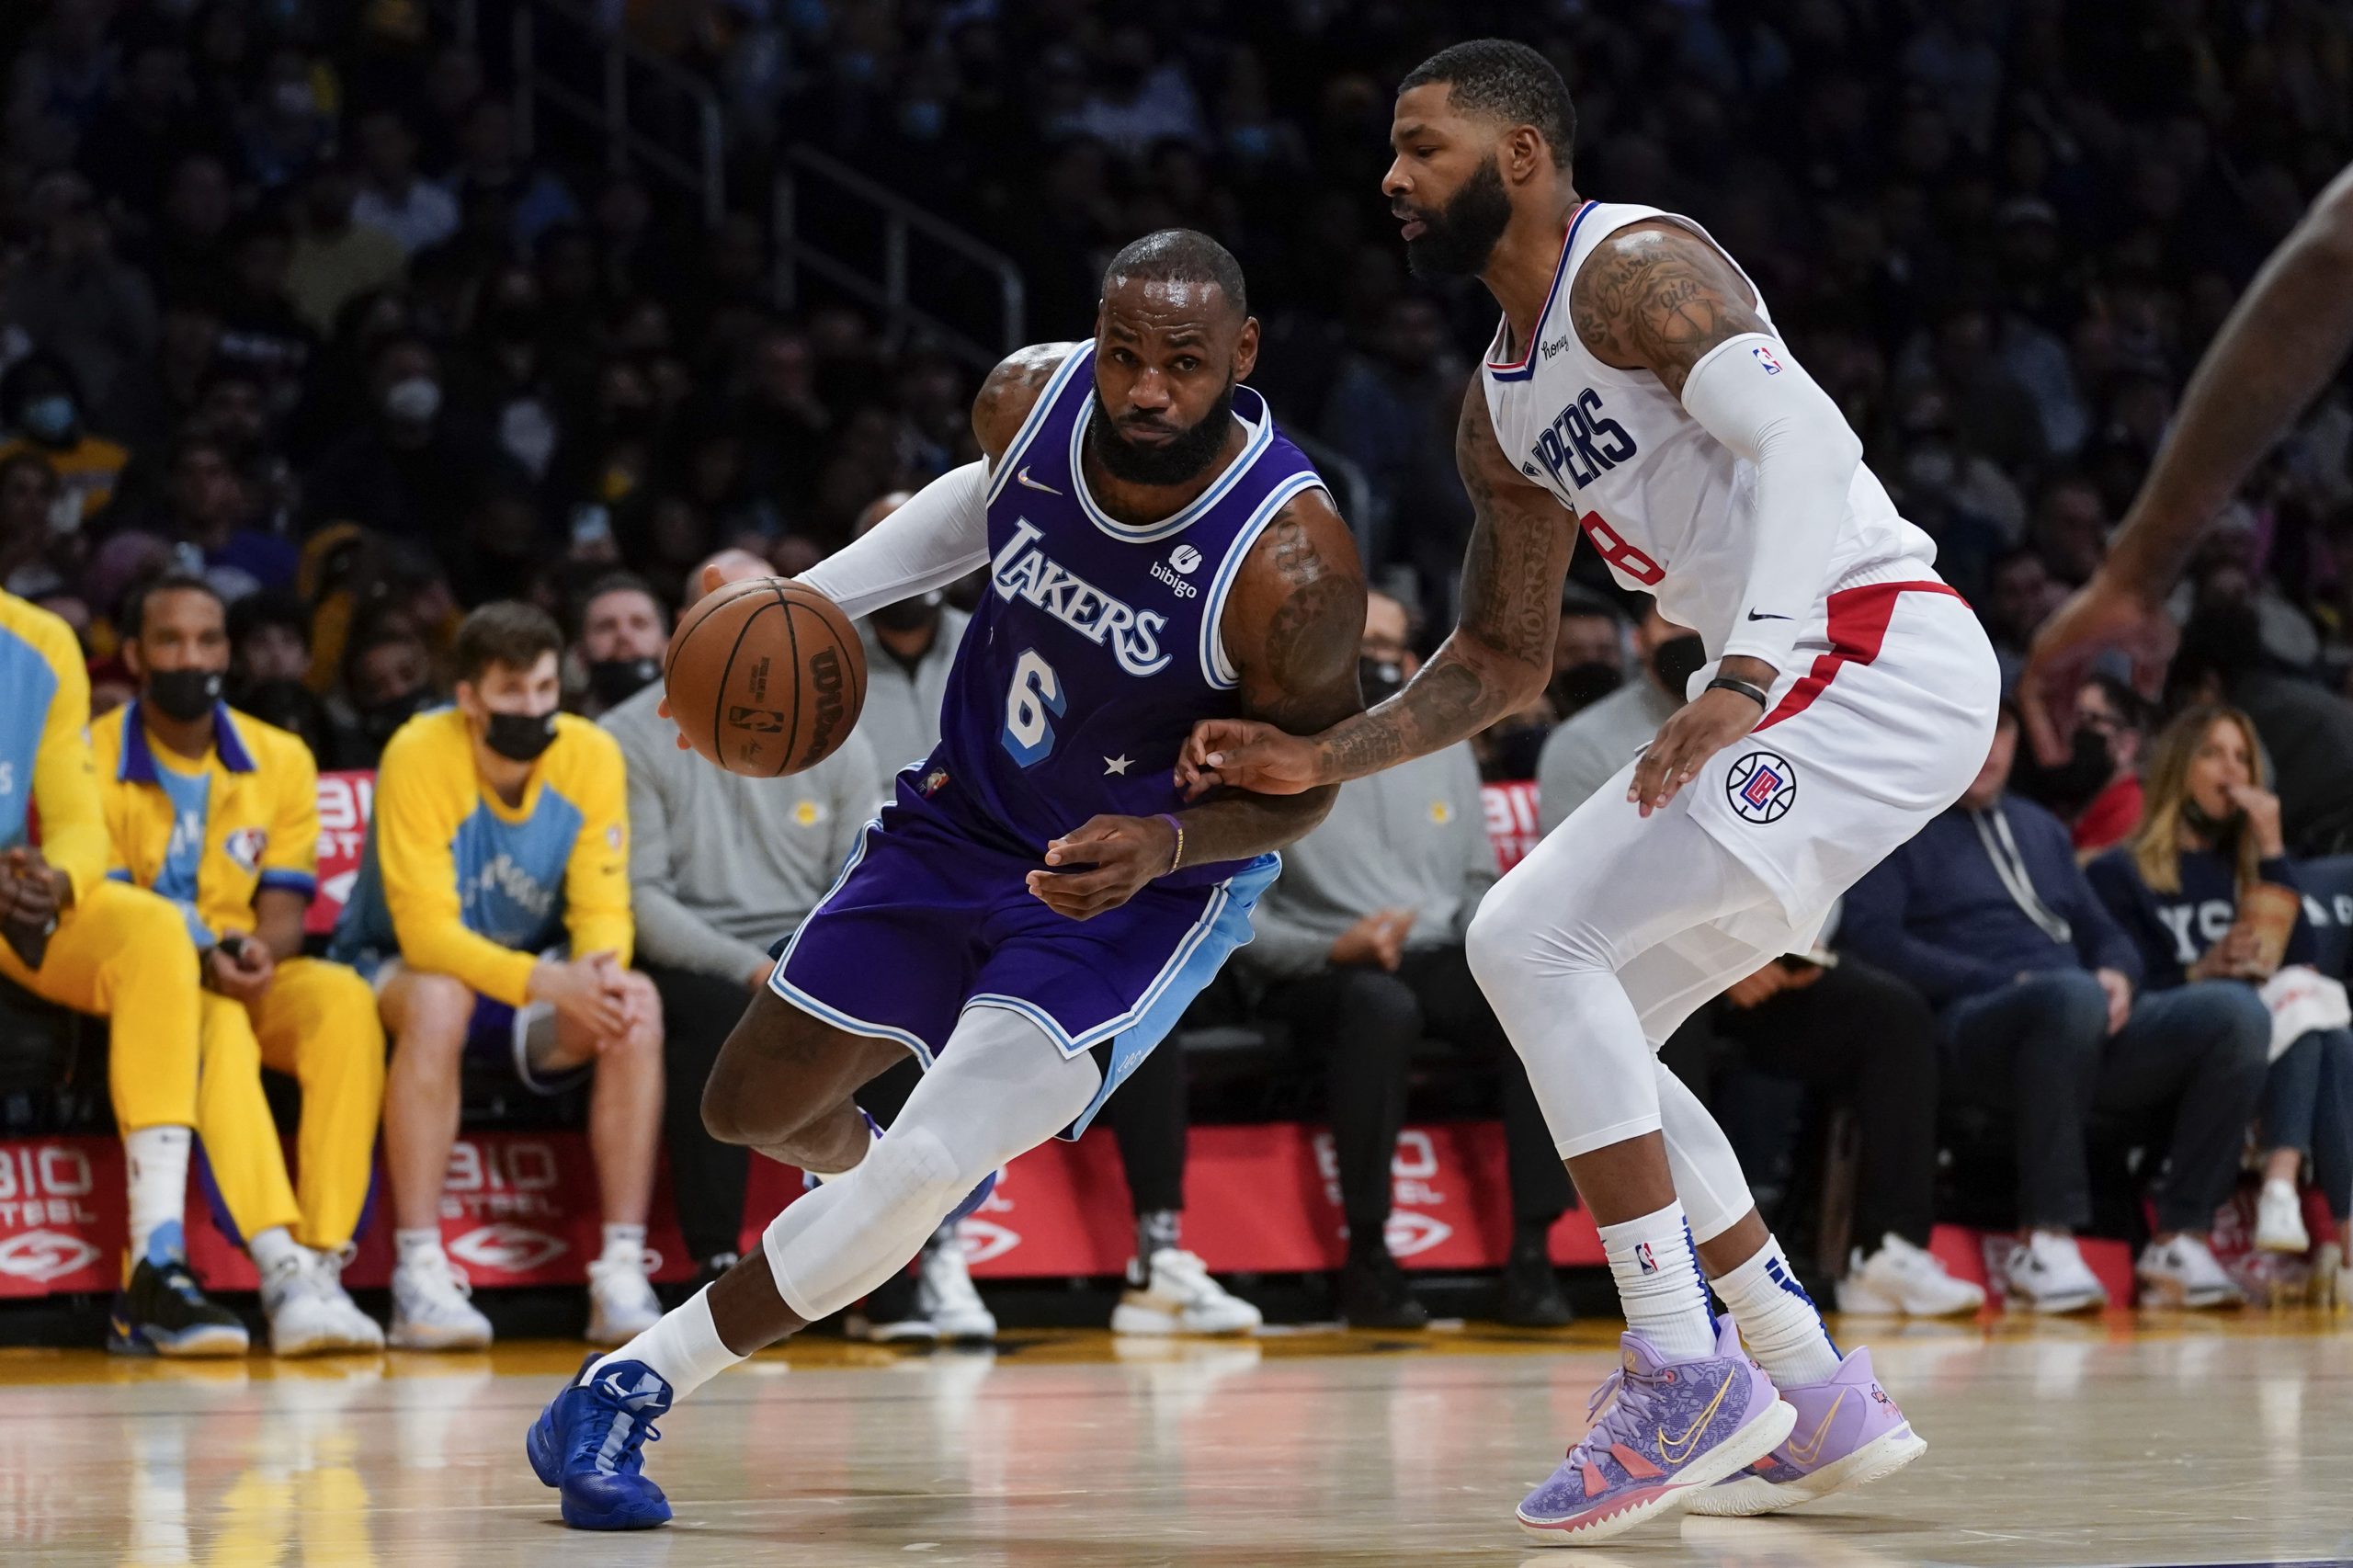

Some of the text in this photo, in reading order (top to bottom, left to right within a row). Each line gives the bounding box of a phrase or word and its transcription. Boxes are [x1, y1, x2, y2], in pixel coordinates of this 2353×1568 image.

[1540, 334, 1570, 361] honey
[1150, 561, 1199, 599] bibigo
[1580, 510, 1666, 586] 8
[991, 515, 1174, 677] LAKERS
[1001, 647, 1068, 768] 6
